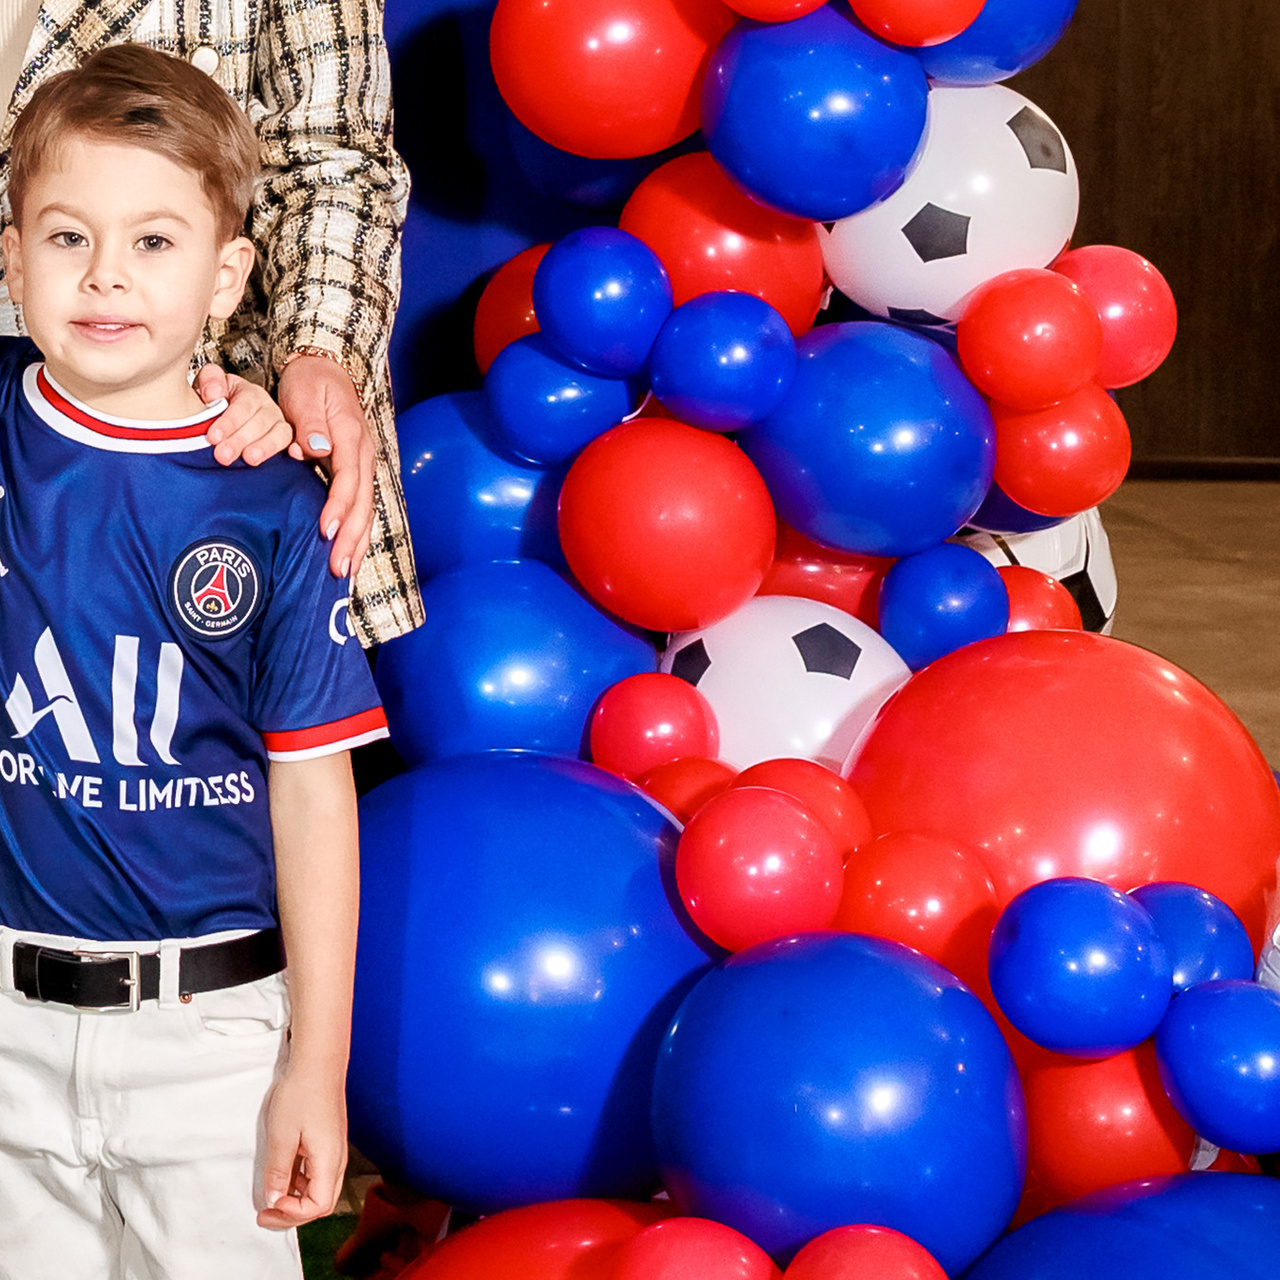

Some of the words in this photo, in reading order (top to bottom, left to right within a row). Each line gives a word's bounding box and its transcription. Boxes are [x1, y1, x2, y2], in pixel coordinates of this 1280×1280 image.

[196, 547, 250, 578] PARIS
[184, 601, 202, 622] SAINT
[205, 615, 238, 628] GERMAIN
[119, 771, 255, 812] LIMITLESS
